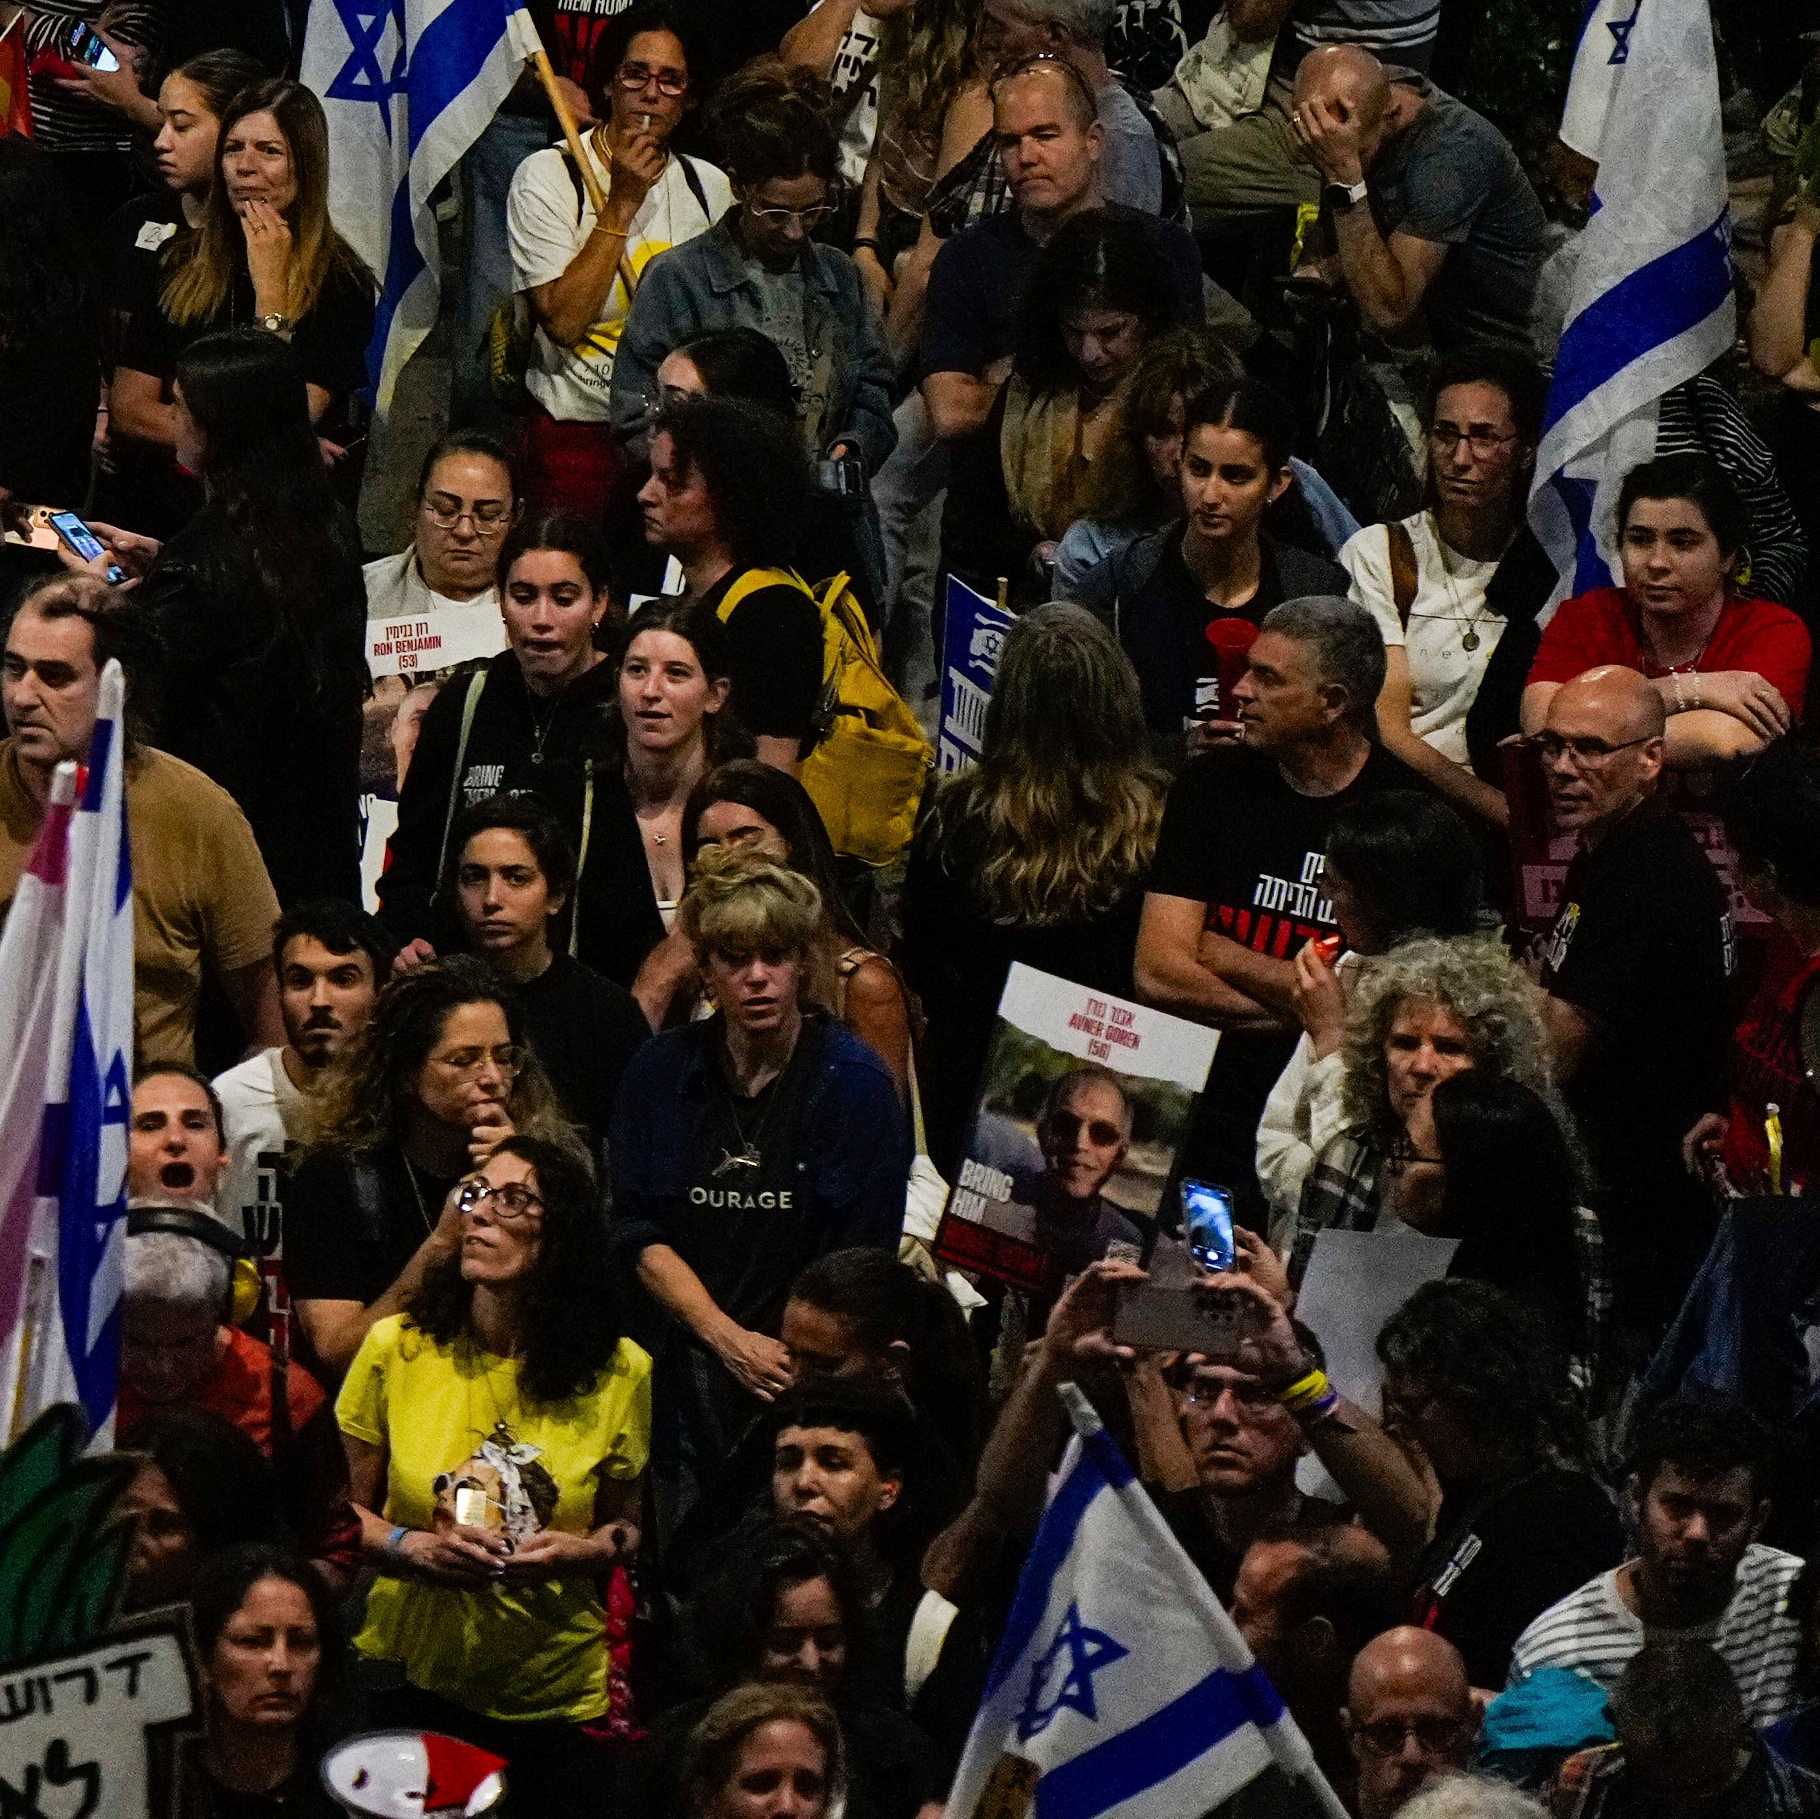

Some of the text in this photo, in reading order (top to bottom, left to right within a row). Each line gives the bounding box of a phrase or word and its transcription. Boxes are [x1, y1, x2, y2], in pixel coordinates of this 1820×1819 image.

[374, 635, 441, 656] RON BENJAMIN
[959, 1158, 1015, 1204] BRING
[949, 1185, 988, 1223] HIM
